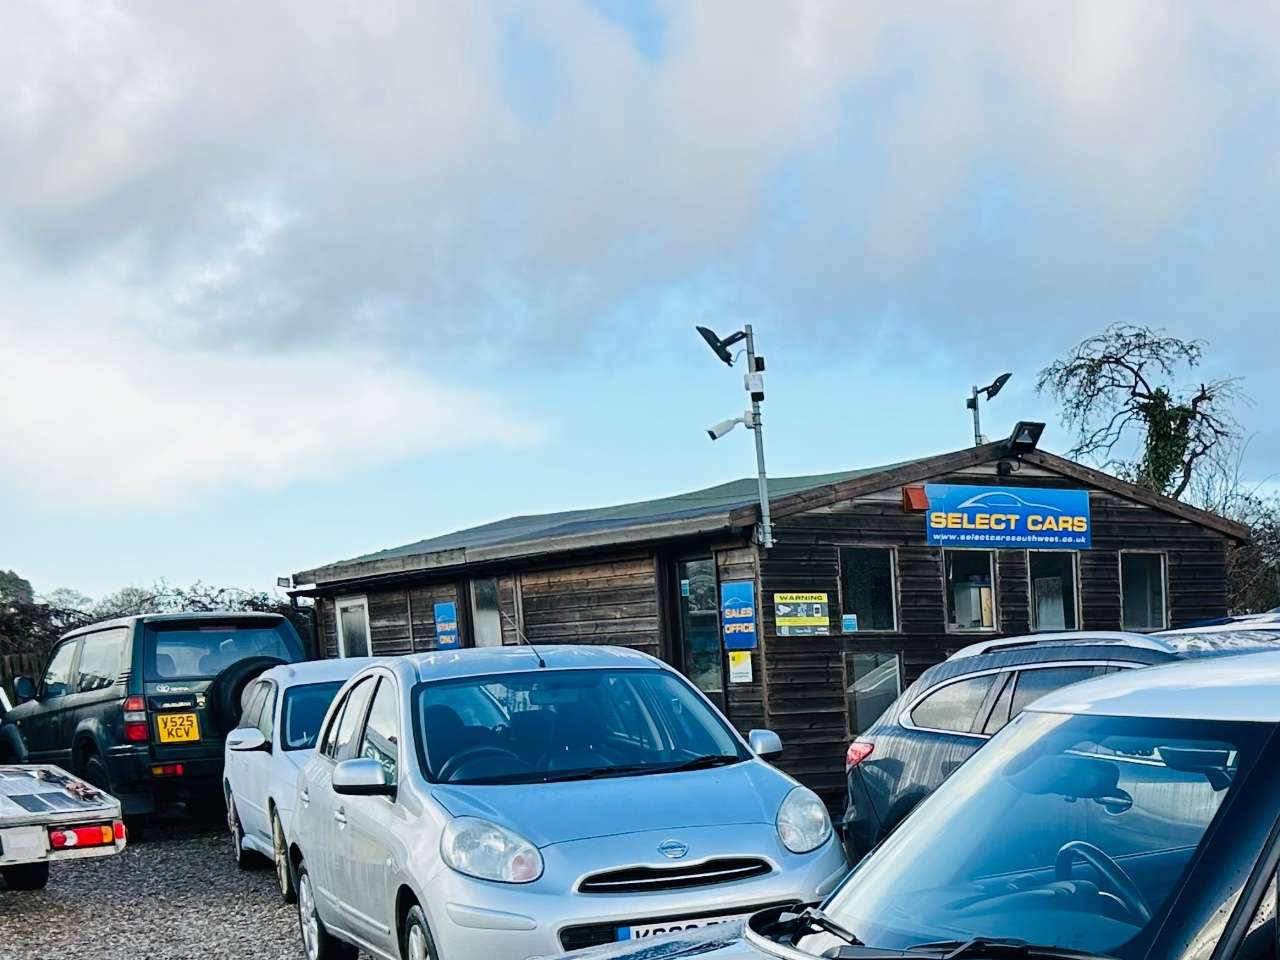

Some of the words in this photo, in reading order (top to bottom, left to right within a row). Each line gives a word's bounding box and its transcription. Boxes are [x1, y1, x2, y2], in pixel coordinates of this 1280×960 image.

[930, 512, 1020, 530] SELECT
[1027, 515, 1088, 532] CARS
[724, 607, 753, 618] SALES
[724, 623, 755, 634] OFFICE
[161, 715, 194, 730] Y525
[167, 727, 190, 739] KCV
